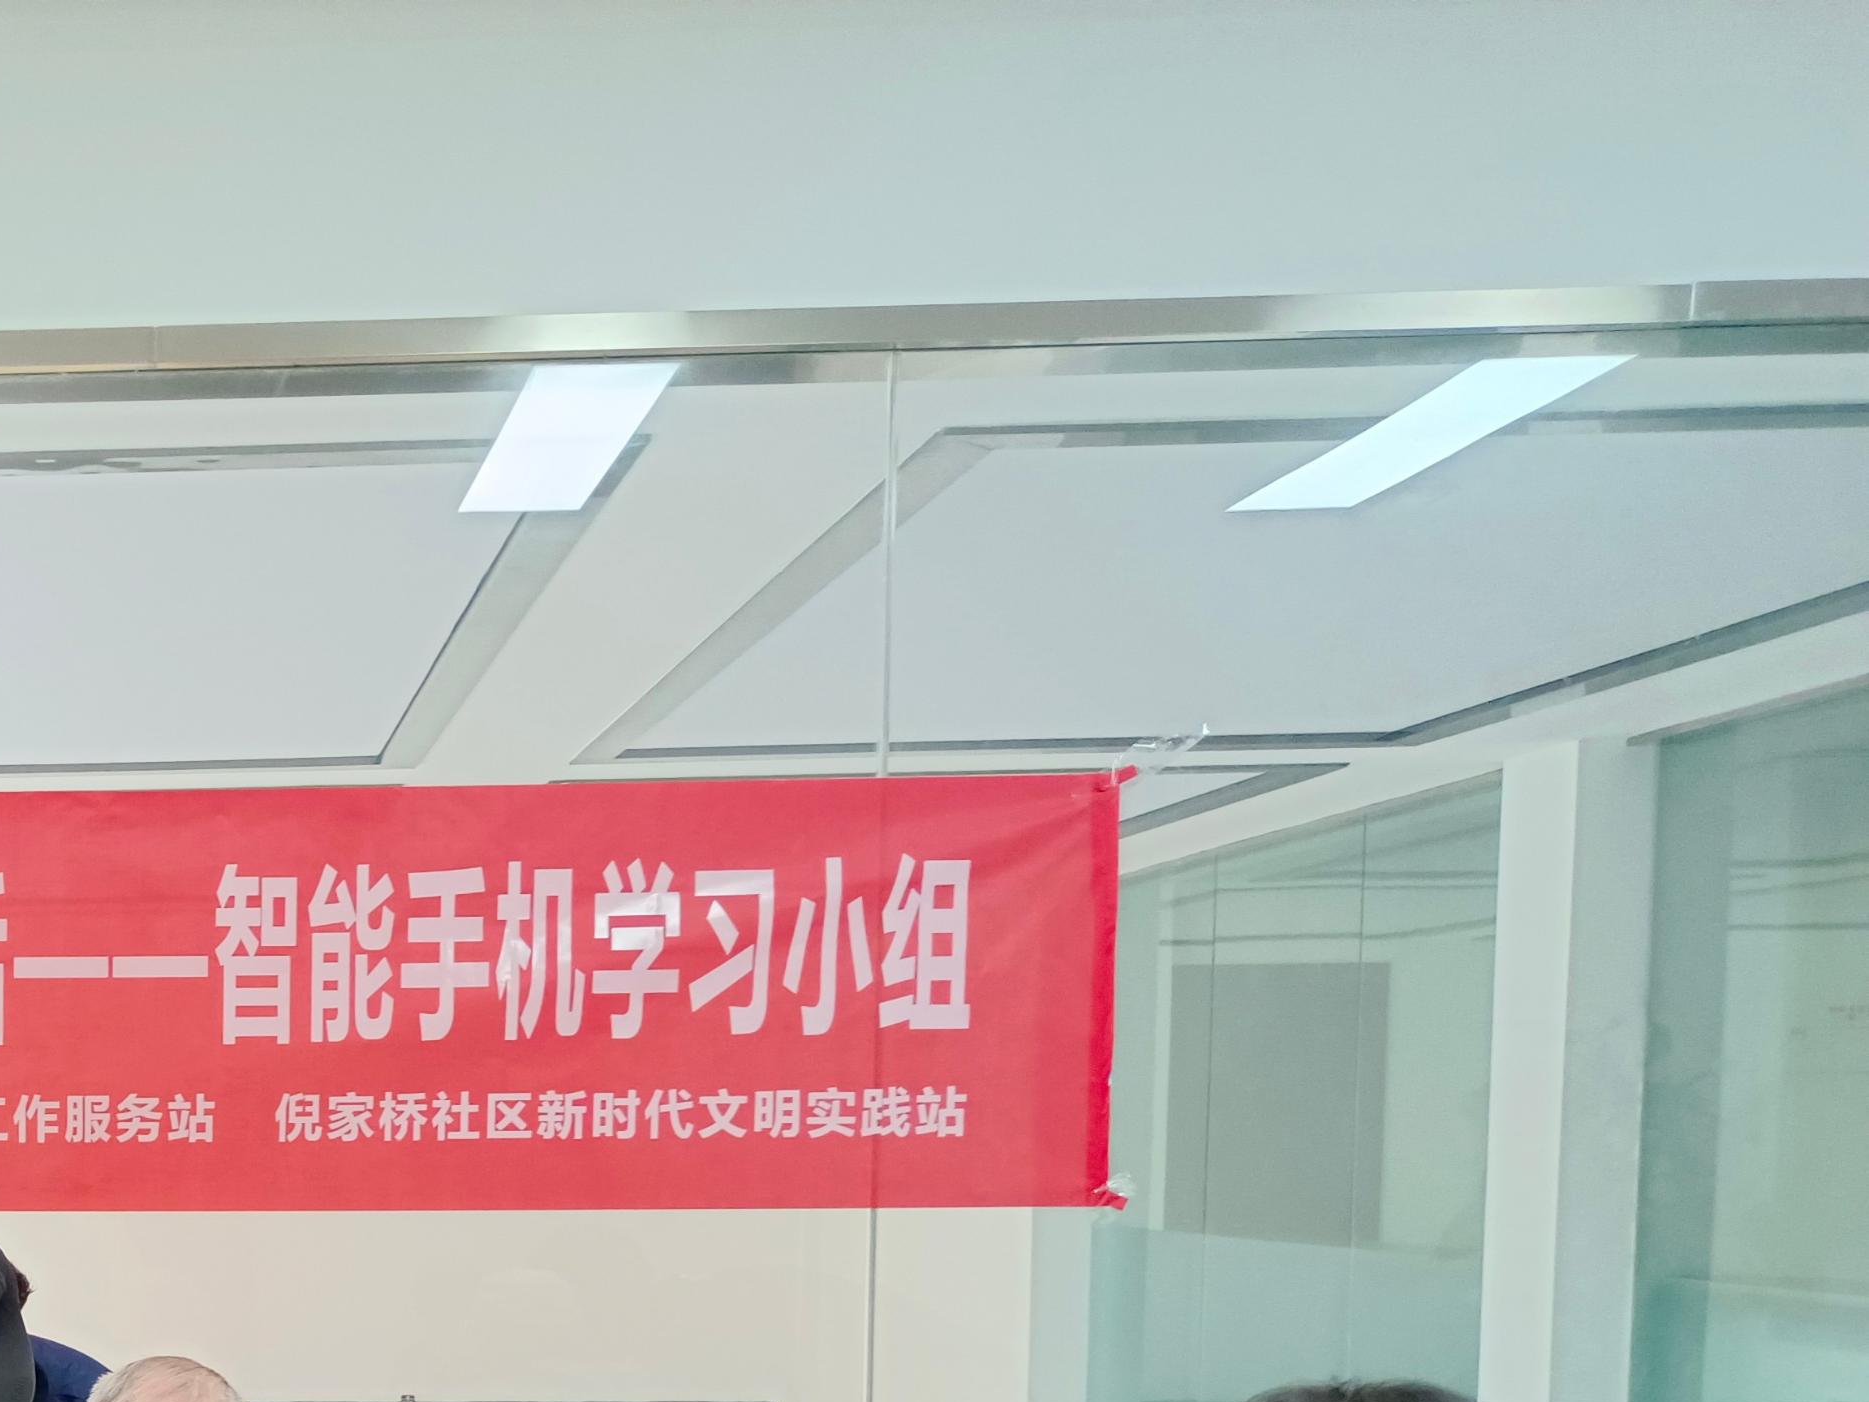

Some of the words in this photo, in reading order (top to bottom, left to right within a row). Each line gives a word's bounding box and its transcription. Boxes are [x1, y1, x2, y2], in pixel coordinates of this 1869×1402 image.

[274, 1086, 968, 1142] 倪家桥社区新时代文明实践站
